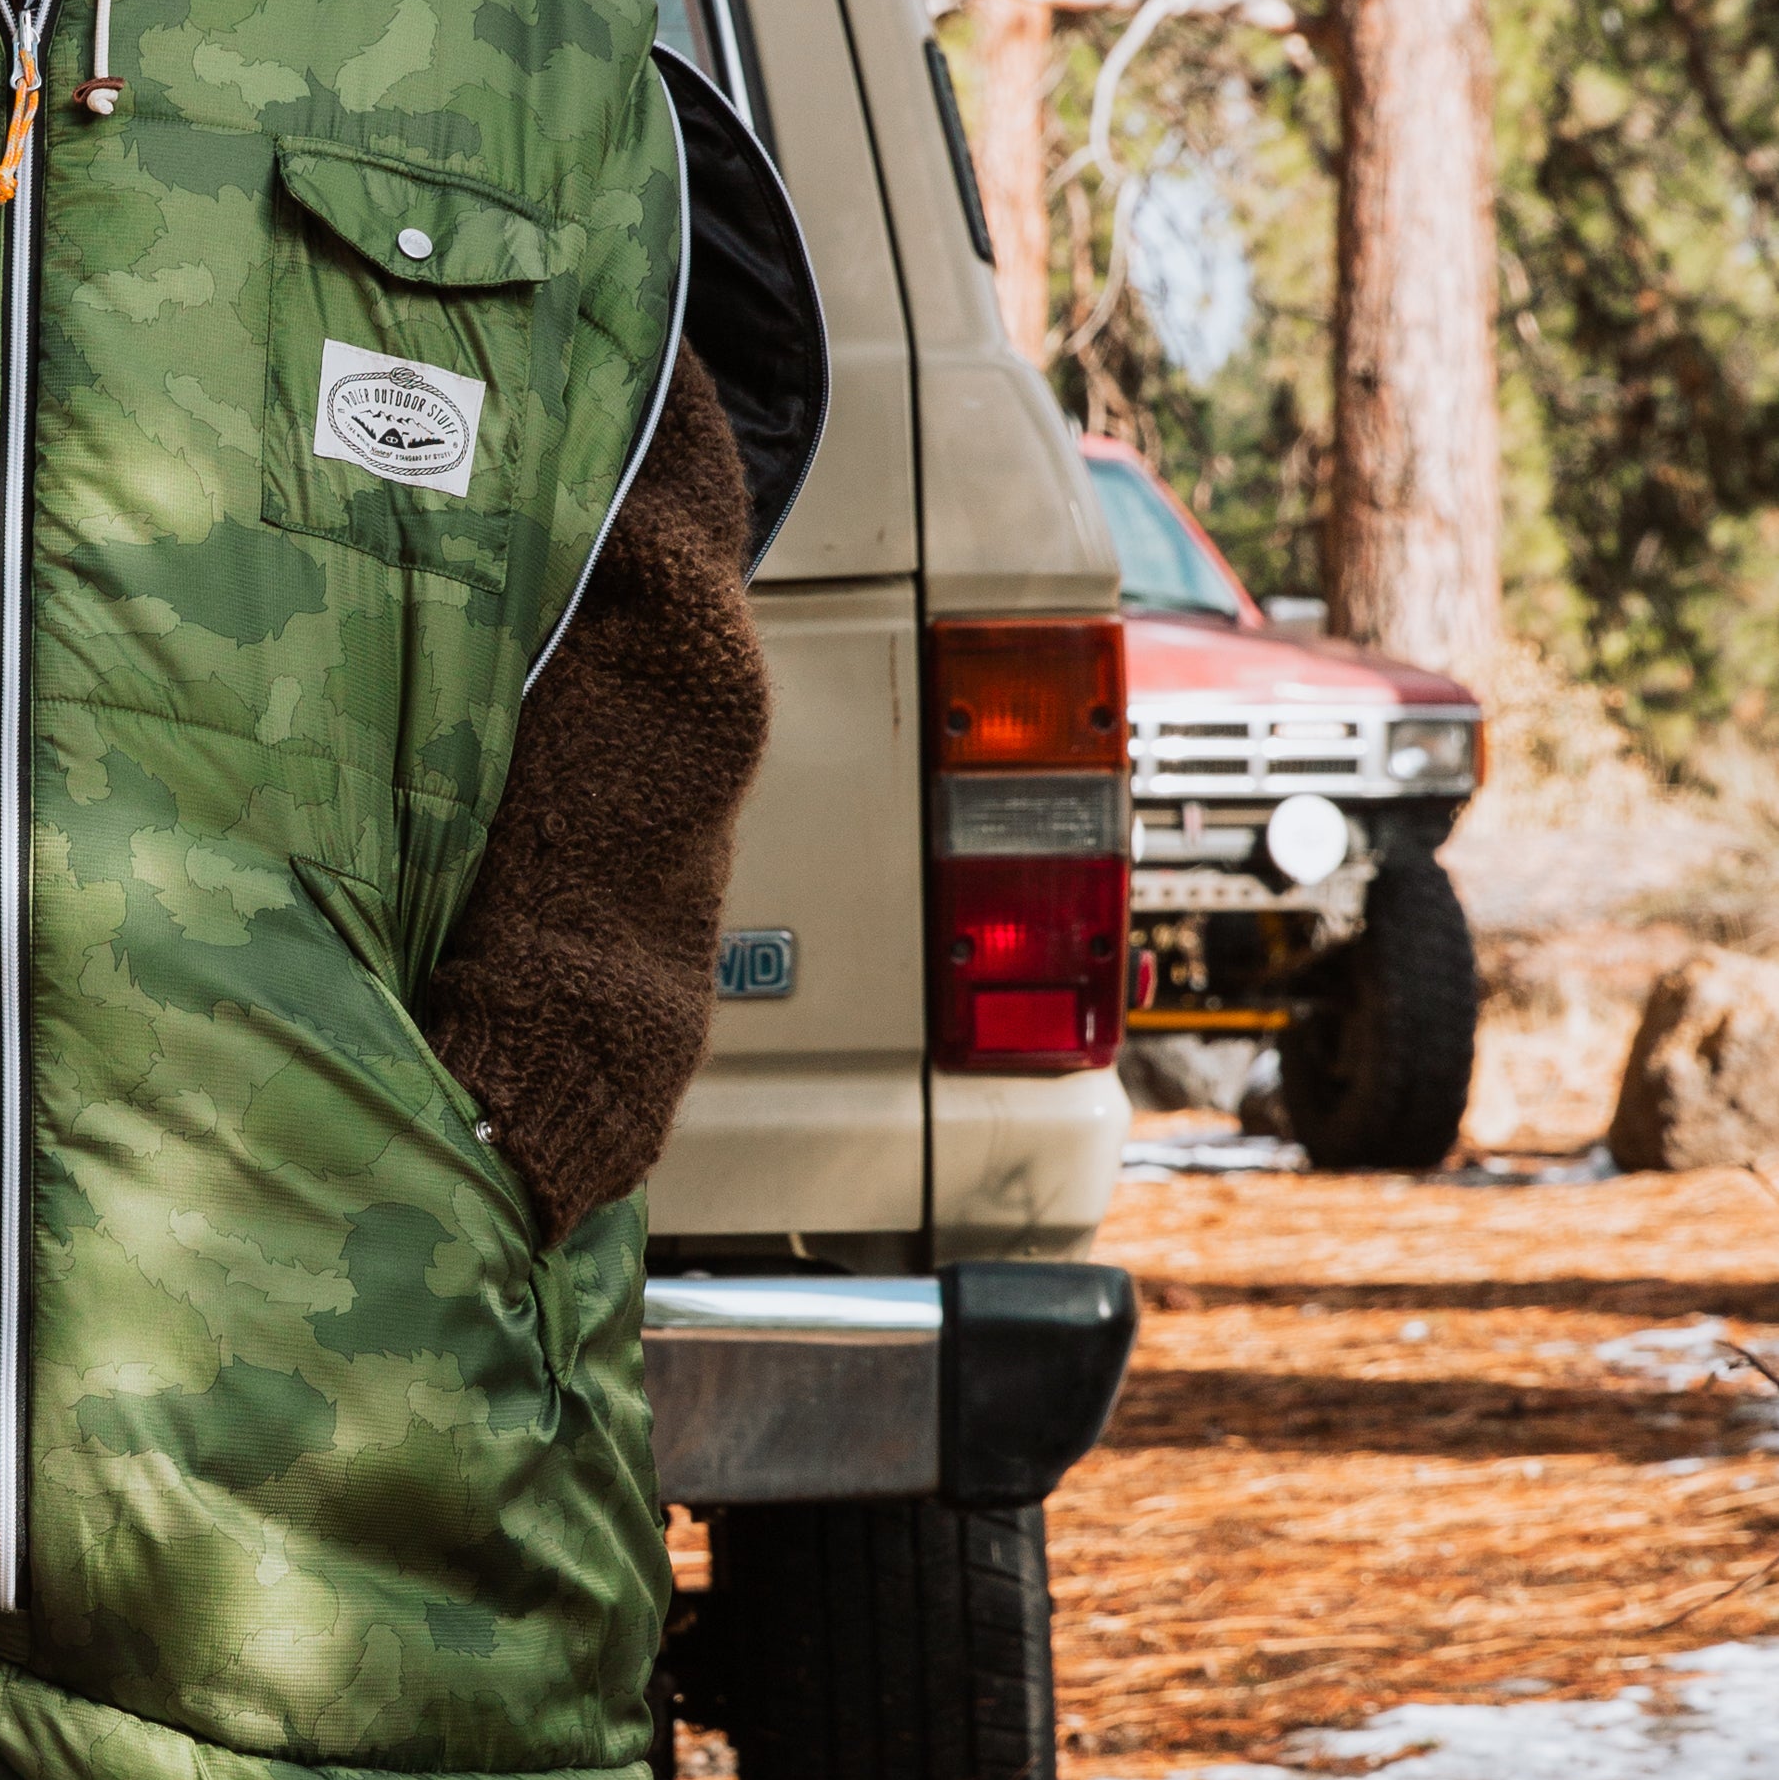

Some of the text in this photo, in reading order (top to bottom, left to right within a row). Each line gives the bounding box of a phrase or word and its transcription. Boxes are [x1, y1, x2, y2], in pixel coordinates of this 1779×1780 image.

[341, 388, 459, 435] POLER OUTDOOR STUFF
